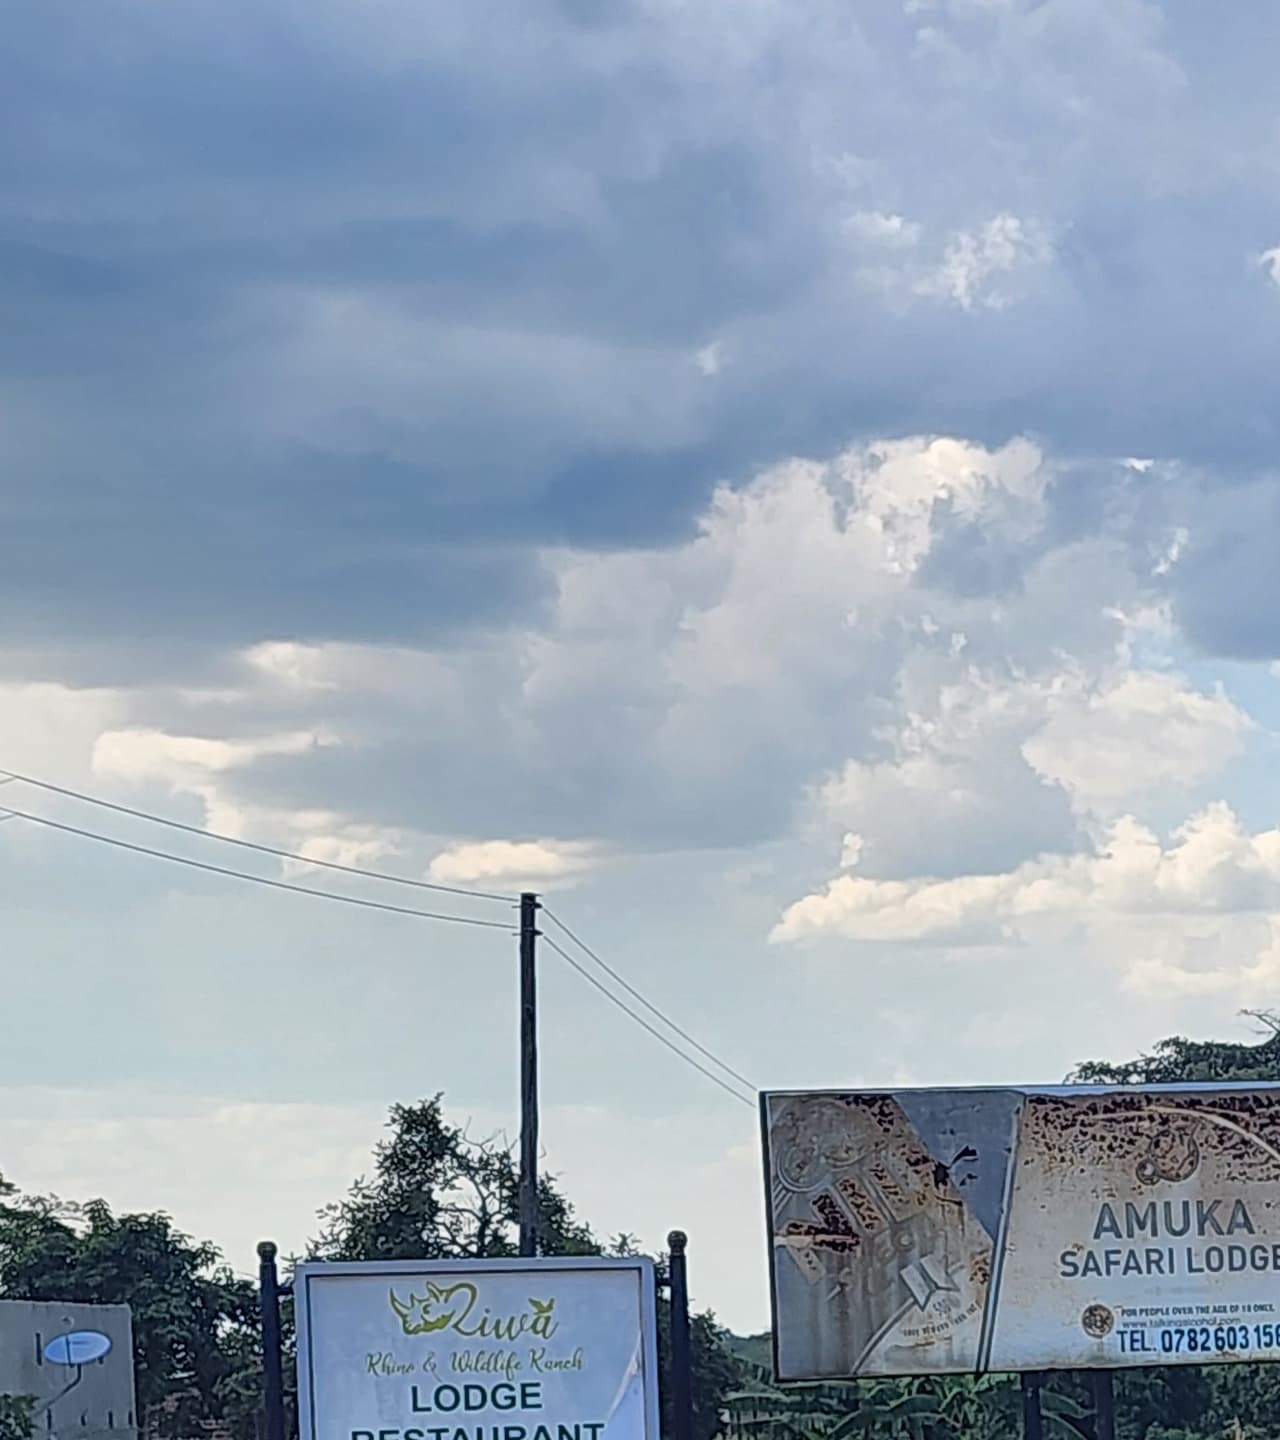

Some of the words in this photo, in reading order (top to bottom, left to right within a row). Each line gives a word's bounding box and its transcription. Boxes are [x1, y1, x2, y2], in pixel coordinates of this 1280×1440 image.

[1093, 1200, 1255, 1240] AMUKA
[1059, 1246, 1177, 1279] SAFARI
[1116, 1330, 1157, 1352] TEL.
[367, 1351, 415, 1377] Rhino
[423, 1351, 443, 1382] &
[450, 1350, 523, 1381] Wildlife
[529, 1347, 583, 1374] Ranch
[411, 1382, 543, 1412] LODGE
